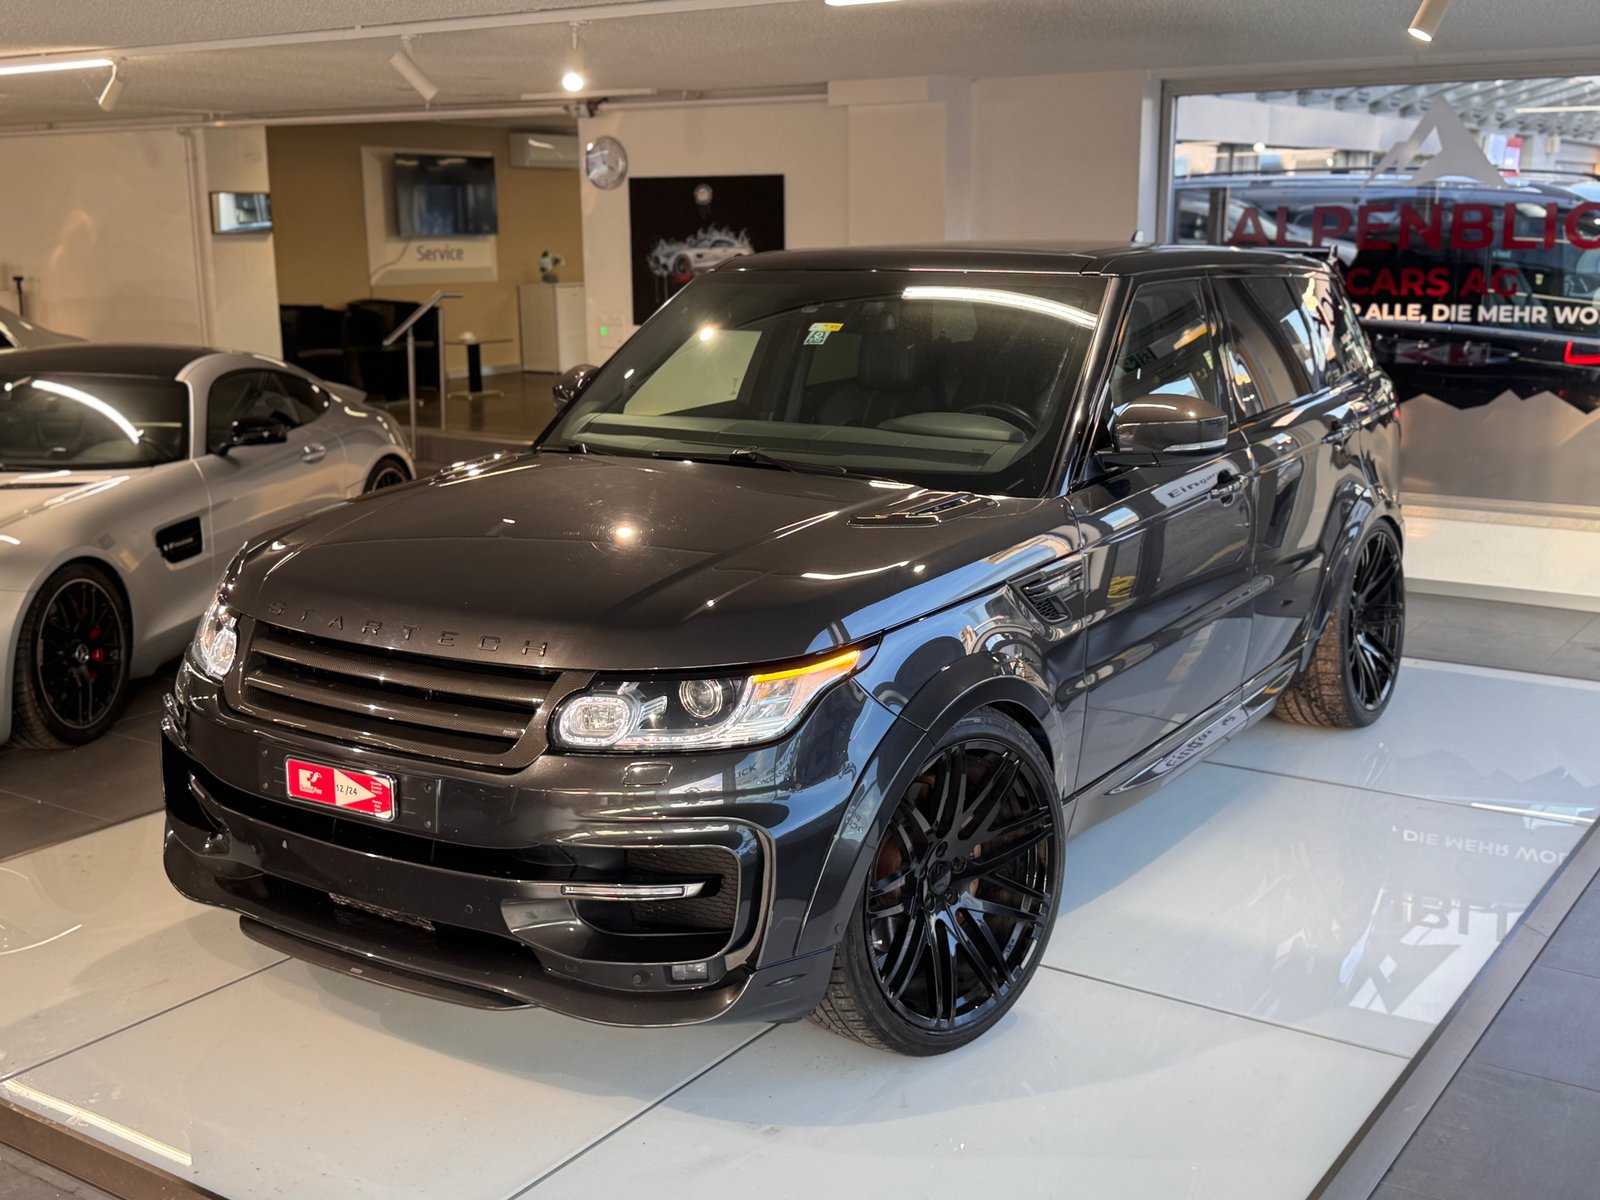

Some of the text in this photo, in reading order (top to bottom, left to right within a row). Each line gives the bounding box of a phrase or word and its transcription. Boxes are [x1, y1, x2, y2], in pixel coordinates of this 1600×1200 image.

[416, 244, 464, 262] Service
[1346, 268, 1518, 297] CARS AG
[1366, 303, 1427, 324] ALLE,
[1432, 304, 1471, 323] DIE
[1478, 305, 1547, 325] MEHR
[268, 601, 548, 657] STARTECH
